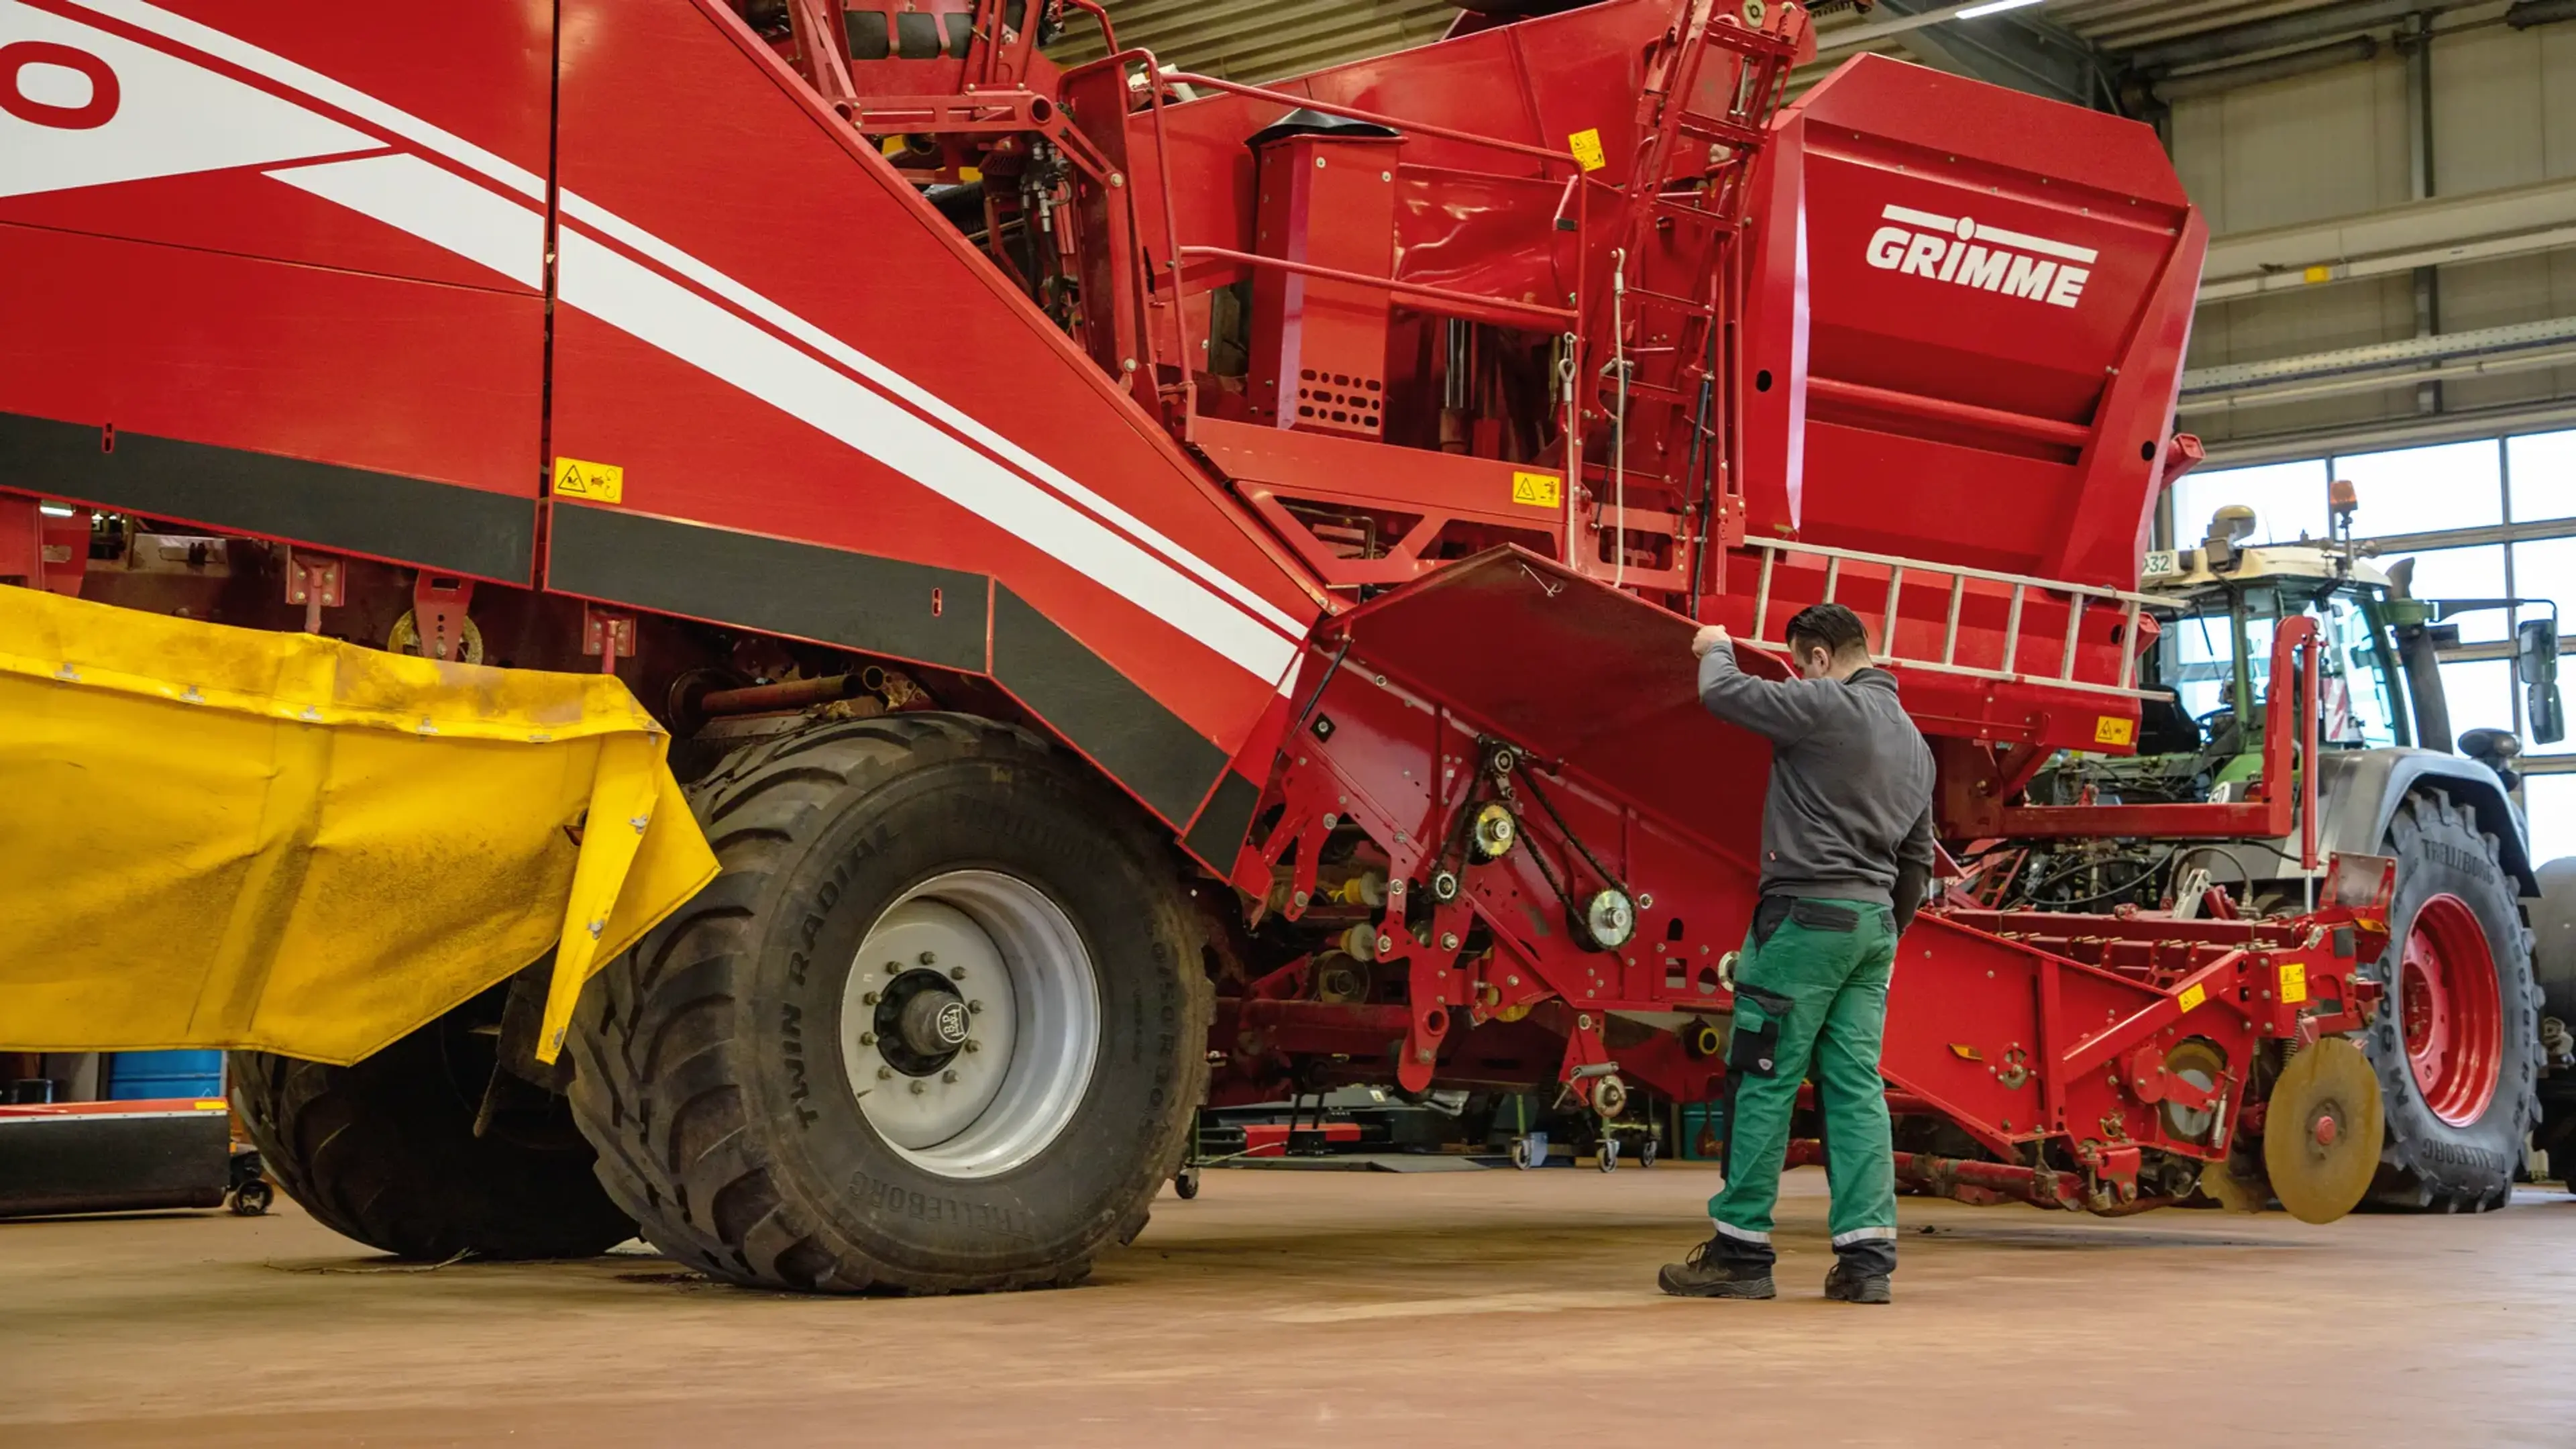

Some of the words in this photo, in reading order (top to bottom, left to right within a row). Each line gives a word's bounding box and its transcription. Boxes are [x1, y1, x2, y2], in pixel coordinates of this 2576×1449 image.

[1866, 216, 2090, 309] GRIMME
[788, 823, 900, 987] RADIAL
[780, 1000, 820, 1130] TWIN
[847, 1171, 1034, 1245] TRELLEBORG
